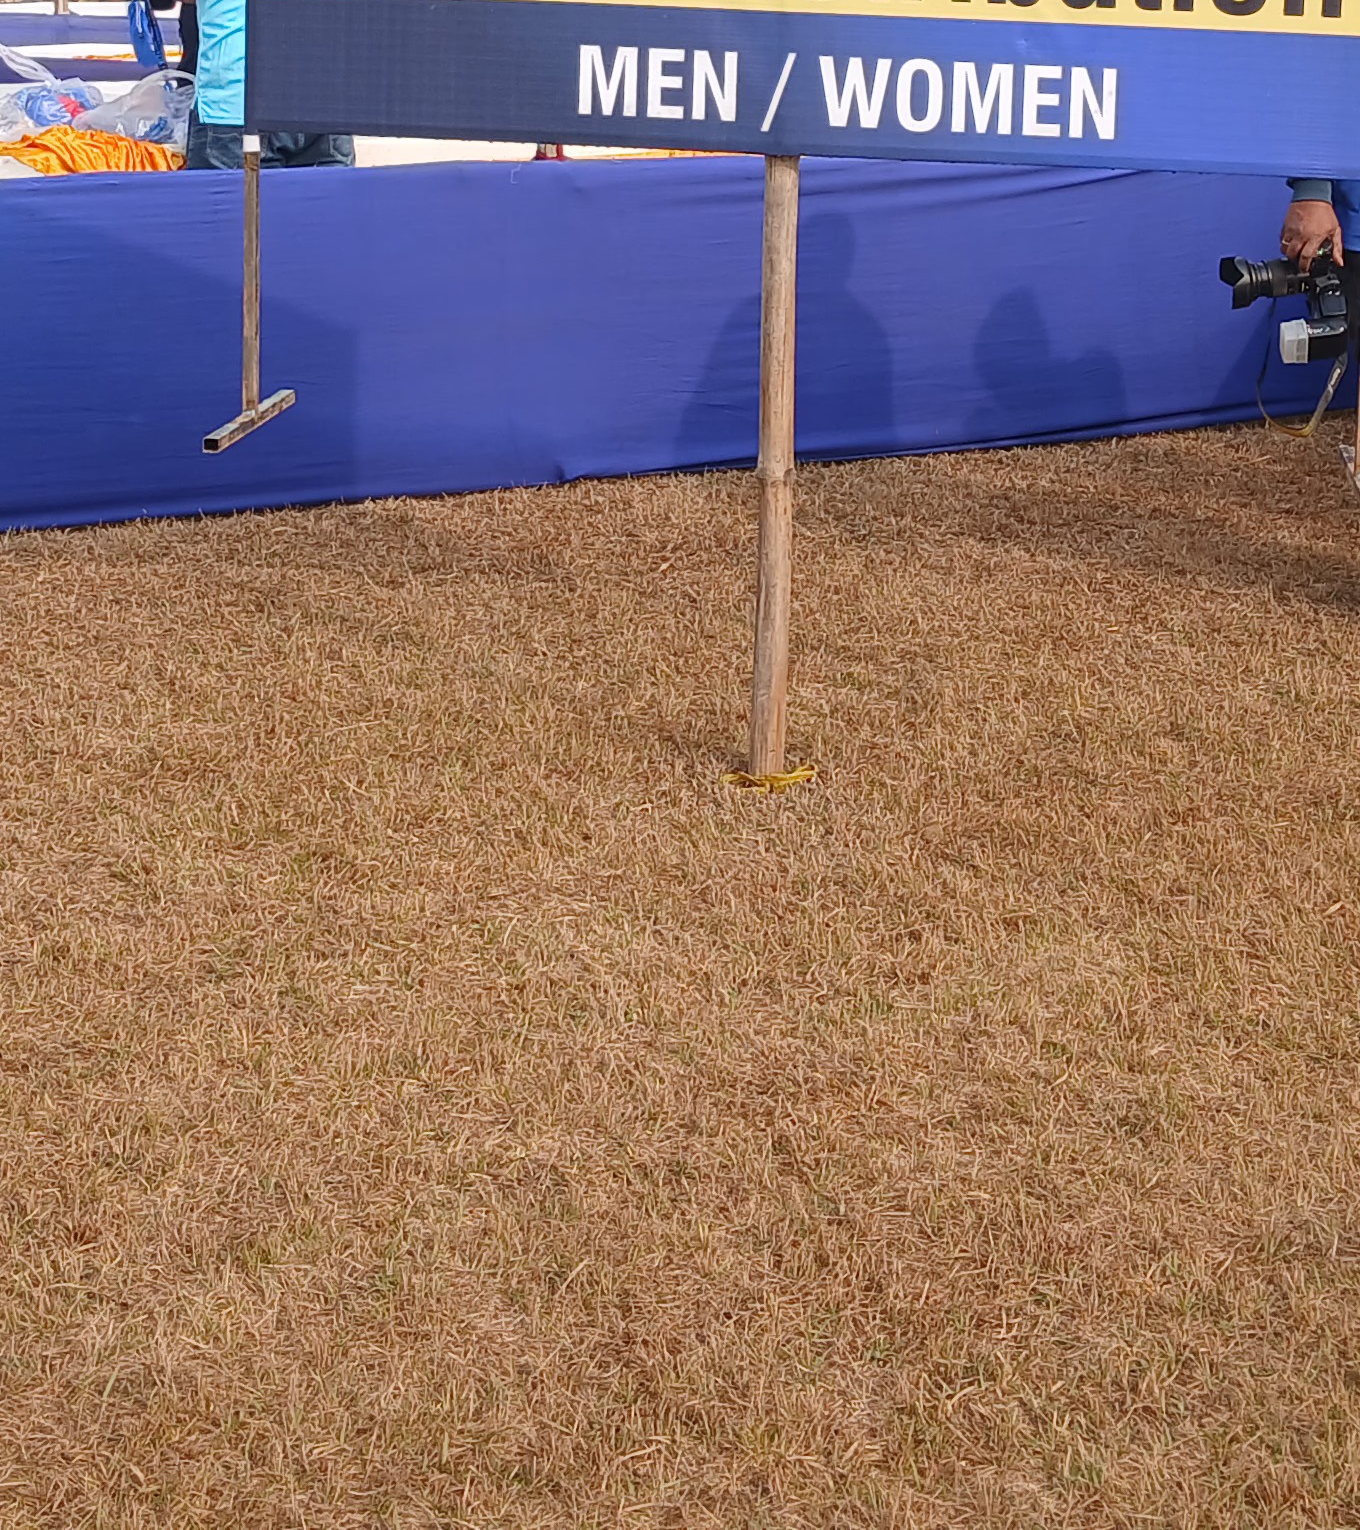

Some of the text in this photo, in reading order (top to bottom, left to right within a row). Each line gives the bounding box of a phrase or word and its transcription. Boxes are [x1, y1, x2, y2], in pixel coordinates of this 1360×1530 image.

[578, 45, 1117, 140] MEN / WOMEN
